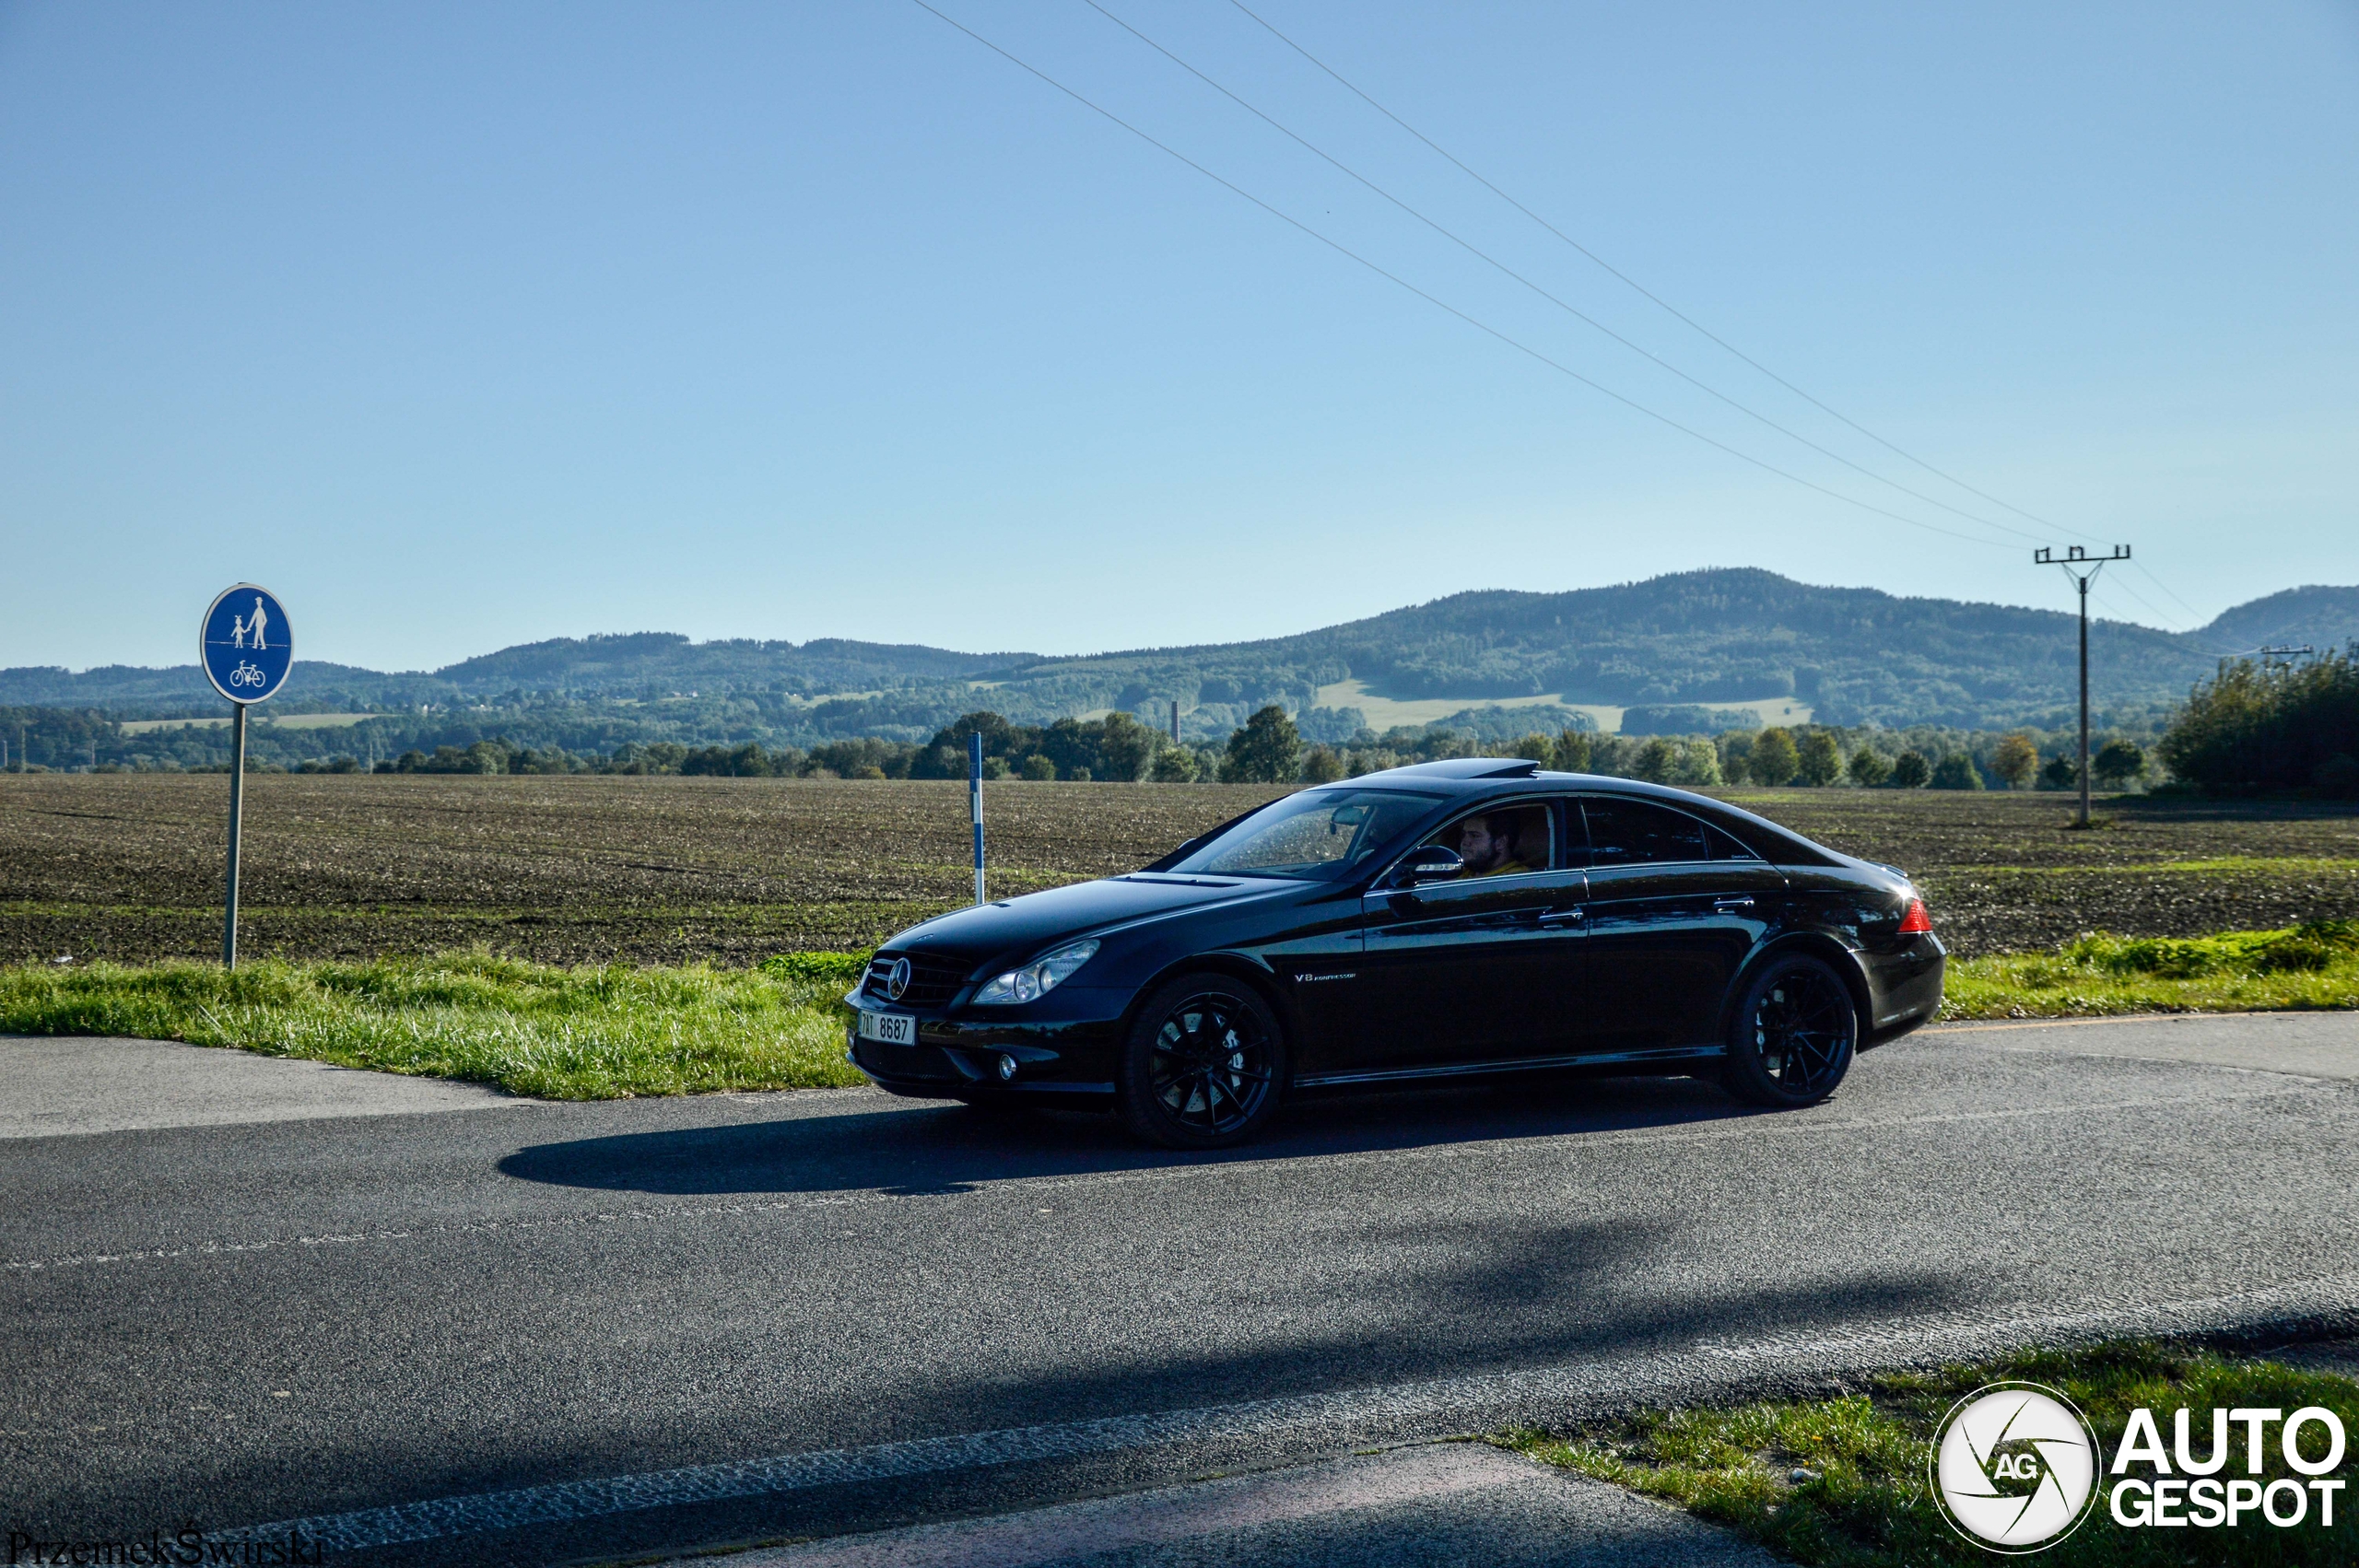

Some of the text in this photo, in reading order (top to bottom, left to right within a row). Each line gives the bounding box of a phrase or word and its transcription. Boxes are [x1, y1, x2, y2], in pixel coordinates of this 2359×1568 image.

[1294, 973, 1313, 982] V8
[863, 1013, 908, 1041] 7AT 8687
